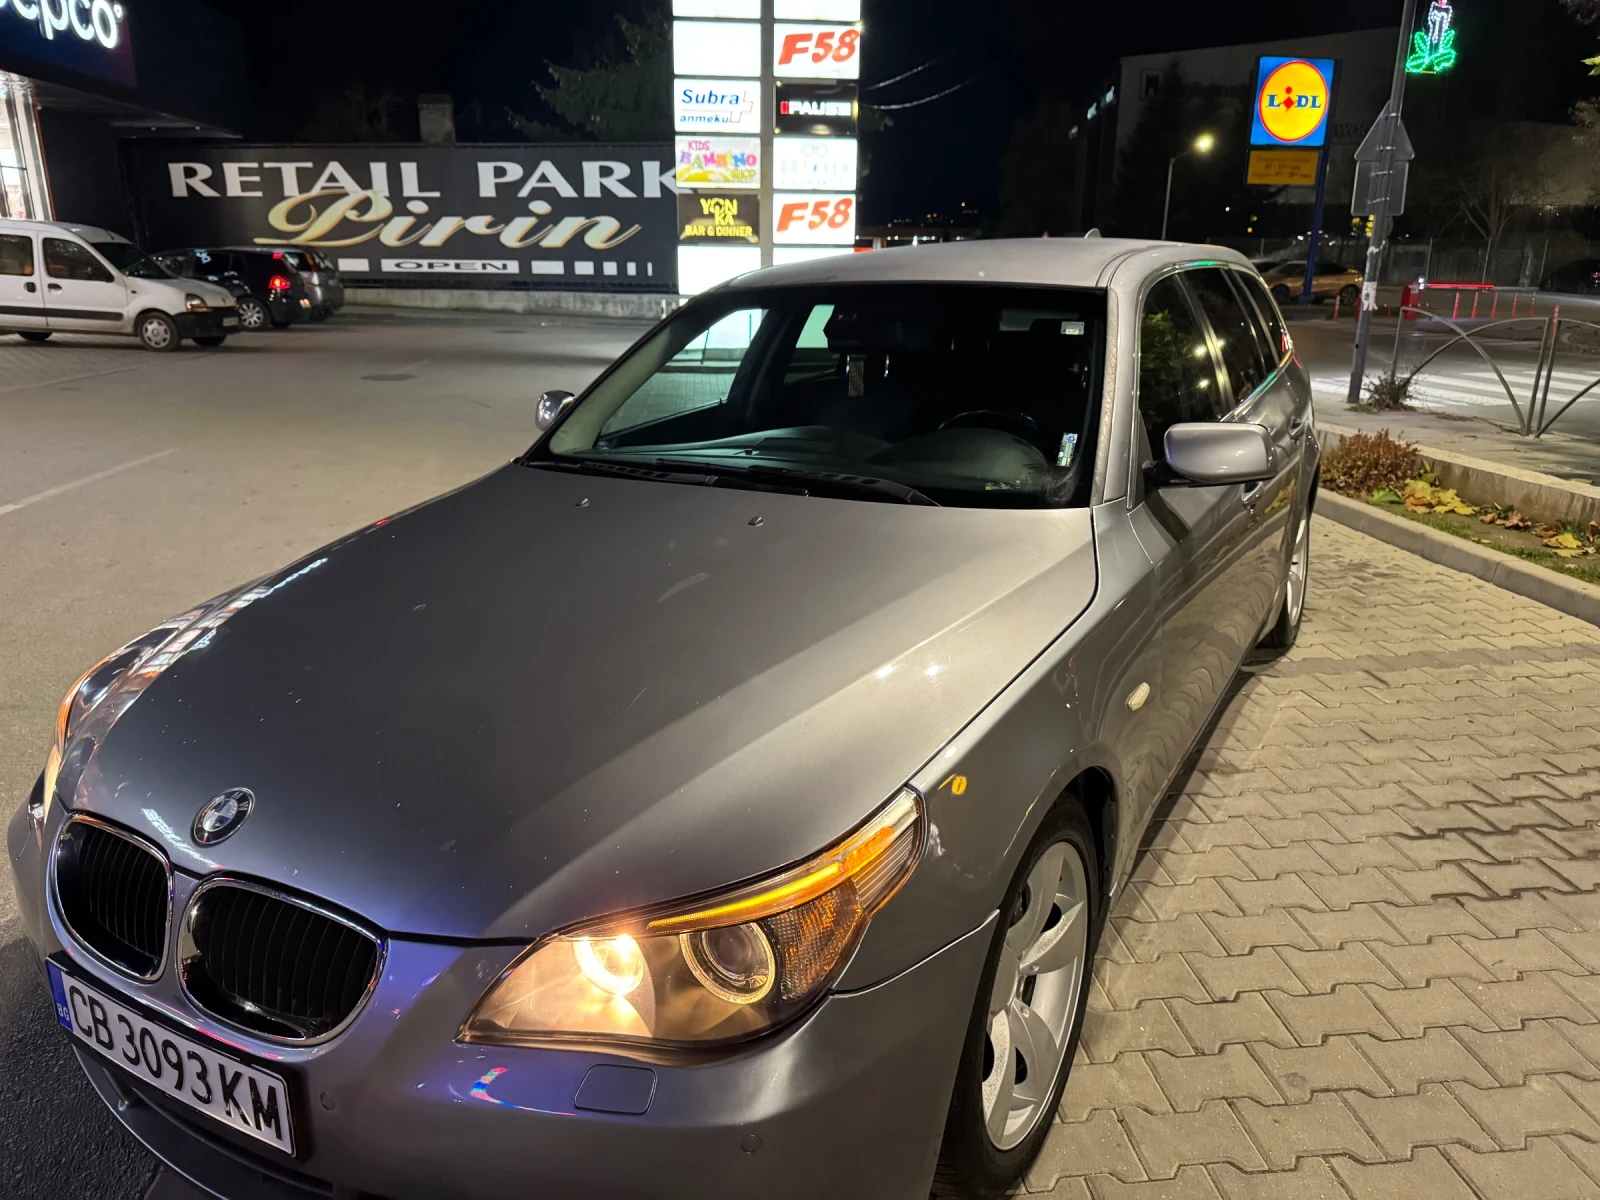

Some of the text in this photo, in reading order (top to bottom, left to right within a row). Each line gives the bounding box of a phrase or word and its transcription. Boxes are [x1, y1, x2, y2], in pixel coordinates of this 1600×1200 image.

[0, 0, 118, 49] pco
[778, 29, 860, 65] F58
[682, 89, 740, 105] Subra
[688, 140, 710, 151] KIDS
[680, 151, 758, 169] BAMBINO
[168, 160, 694, 198] RETAIL PARK
[253, 190, 641, 249] Pirin
[776, 197, 853, 232] F58
[685, 225, 706, 236] BAR
[716, 226, 753, 237] DINNER
[393, 260, 508, 271] OPEN
[56, 1002, 70, 1022] BG
